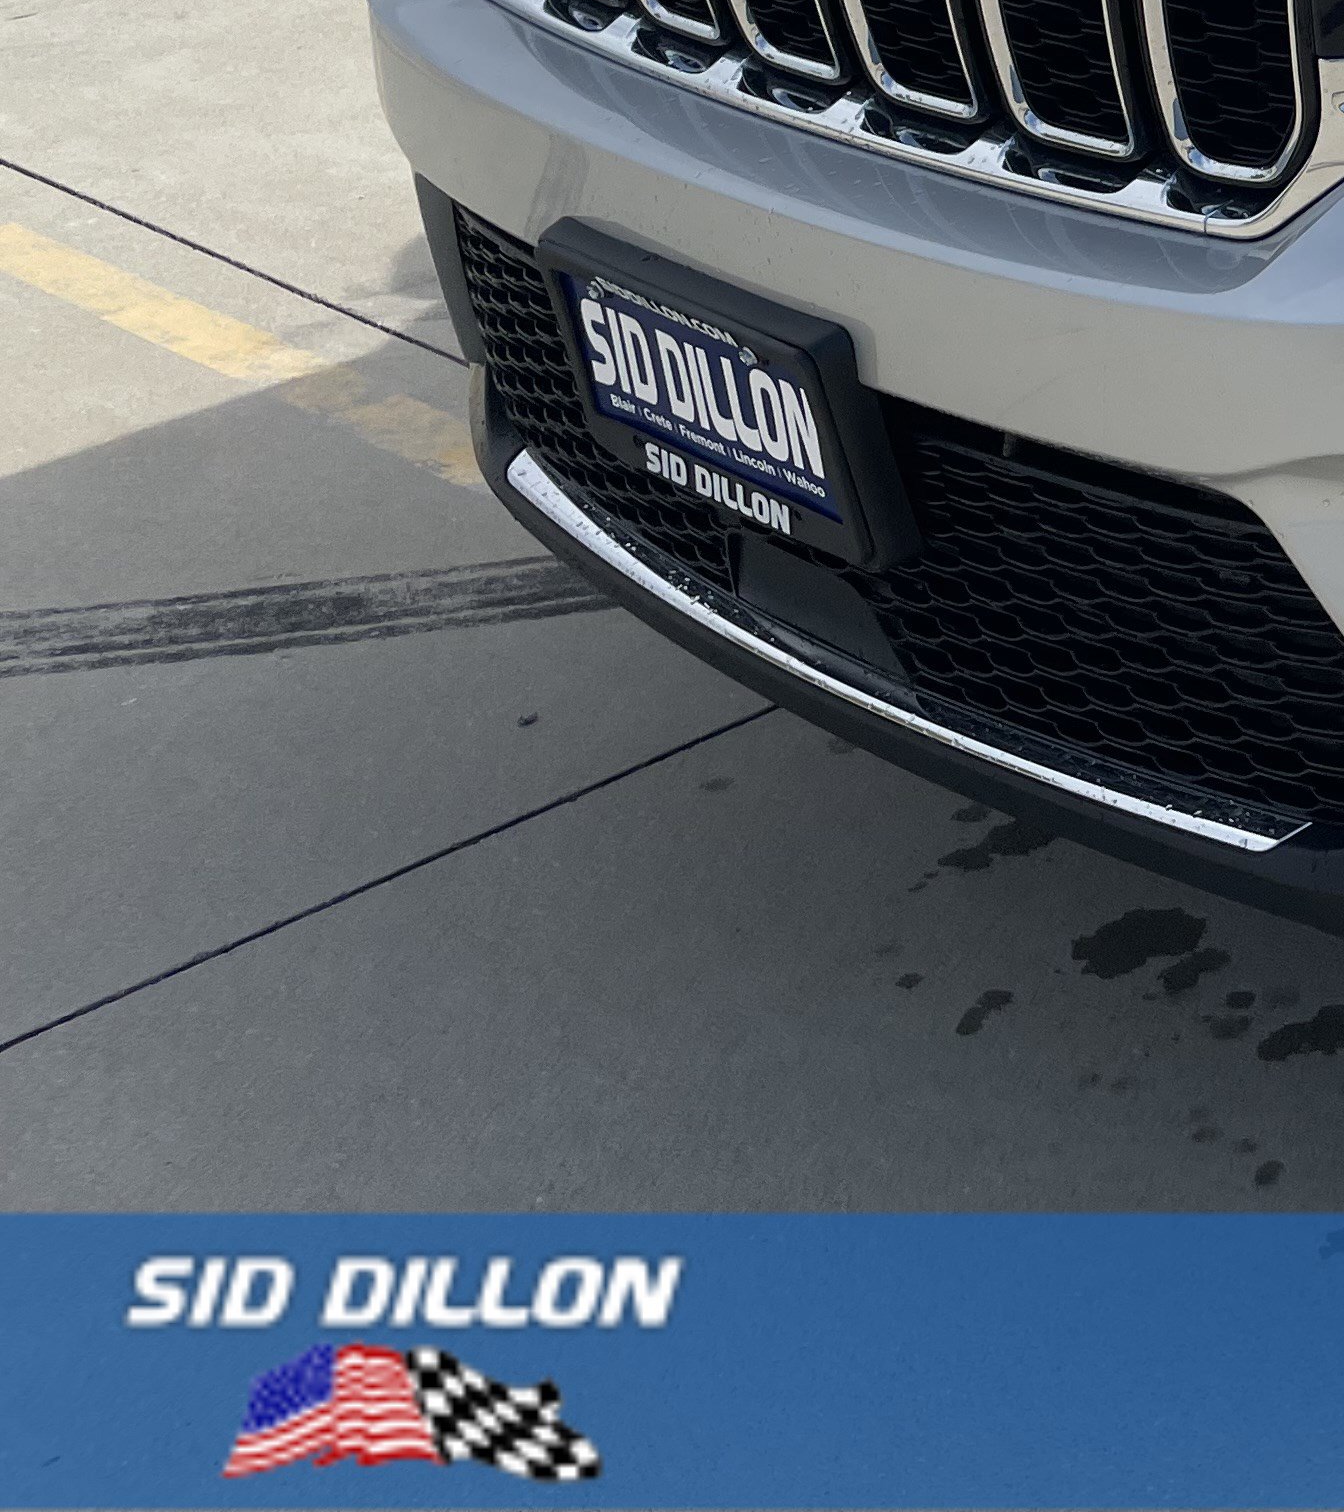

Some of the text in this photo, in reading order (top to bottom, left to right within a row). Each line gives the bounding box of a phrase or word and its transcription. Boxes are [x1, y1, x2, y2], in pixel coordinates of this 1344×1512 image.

[580, 298, 825, 480] SID DILLON
[610, 392, 827, 499] Blair Crete Fremont Lincoln Wahoo
[645, 441, 791, 536] SID DILLON
